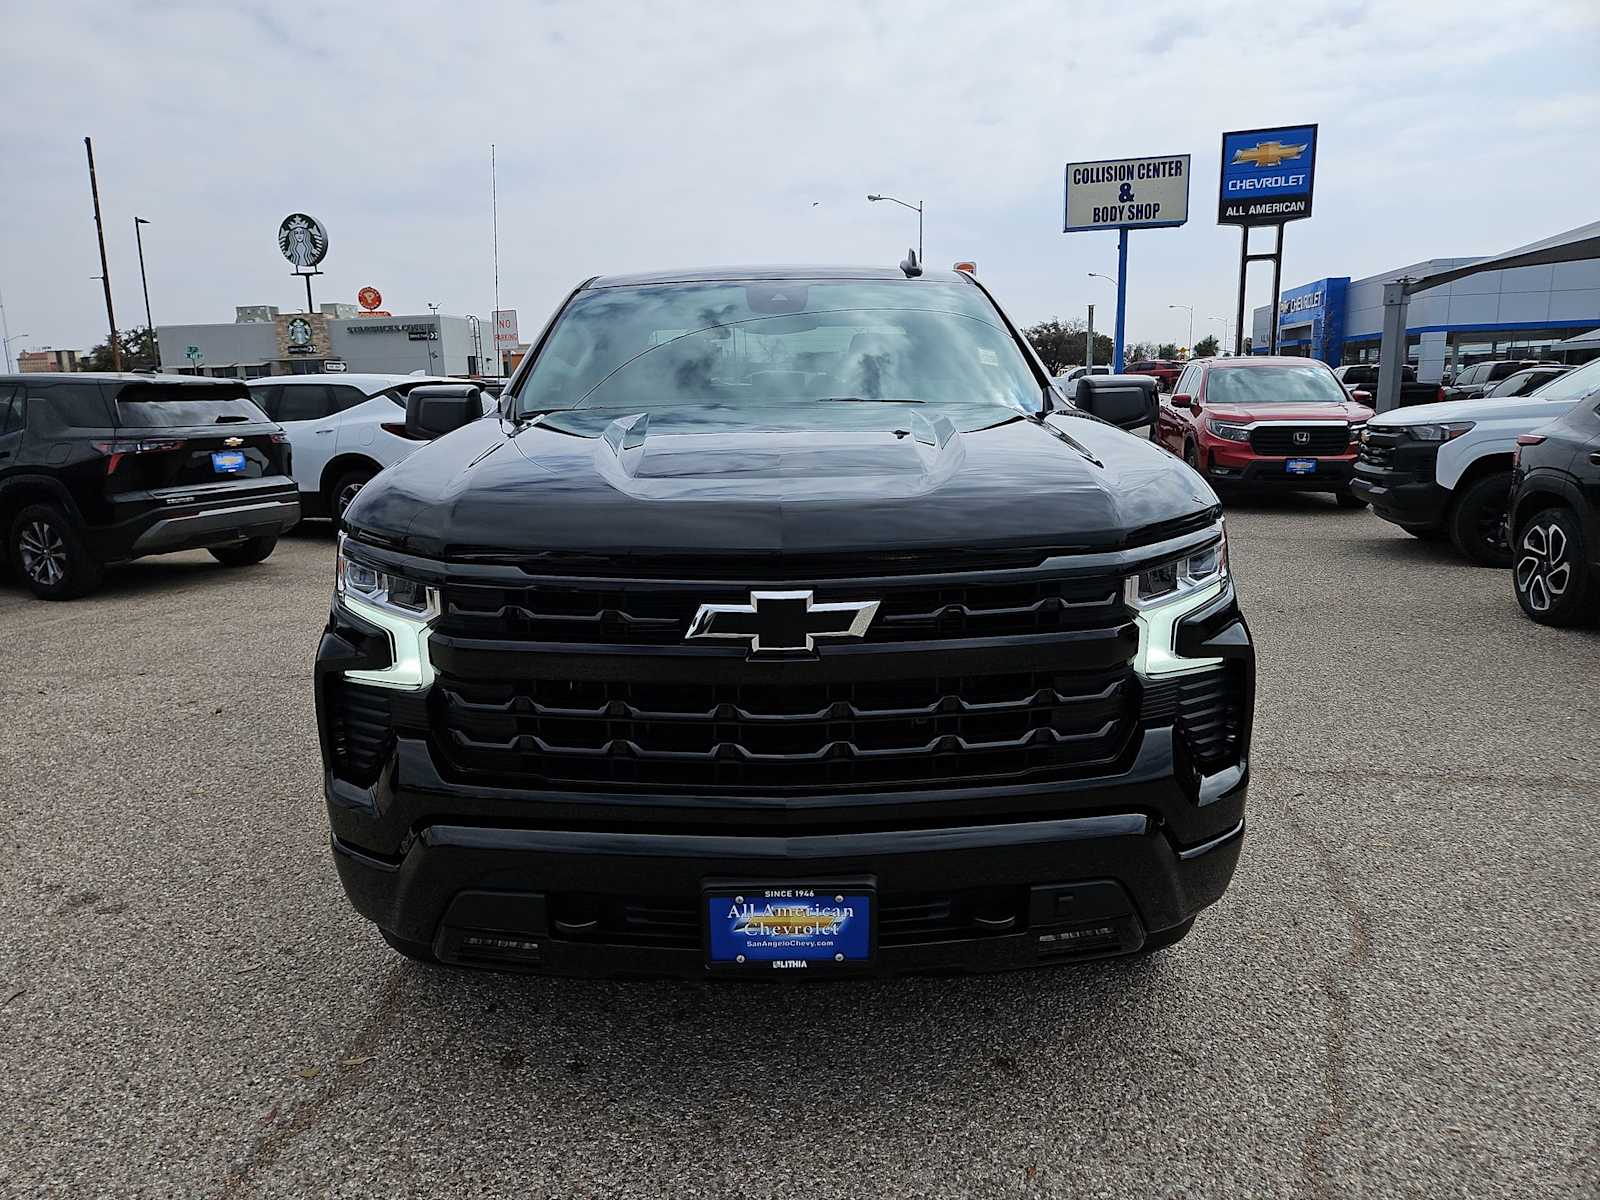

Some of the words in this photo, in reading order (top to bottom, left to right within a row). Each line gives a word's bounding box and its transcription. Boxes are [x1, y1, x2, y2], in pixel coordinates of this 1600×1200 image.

[1073, 164, 1135, 185] COLLISION
[1137, 160, 1183, 180] CENTER
[1228, 174, 1306, 191] CHEVROLET
[1118, 182, 1135, 203] &
[1093, 205, 1125, 223] BODY
[1127, 202, 1161, 221] SHOP
[1225, 205, 1246, 217] ALL
[1248, 201, 1305, 215] AMERICAN
[1290, 291, 1324, 312] CHEVROLET
[499, 319, 511, 329] NO
[765, 890, 793, 898] SINCE
[795, 890, 815, 898] 1946
[727, 903, 756, 919] All
[763, 903, 854, 918] American
[744, 921, 840, 936] Chevrolet
[747, 940, 834, 949] SanAngeloChevy.com
[780, 960, 808, 969] LITHIA
